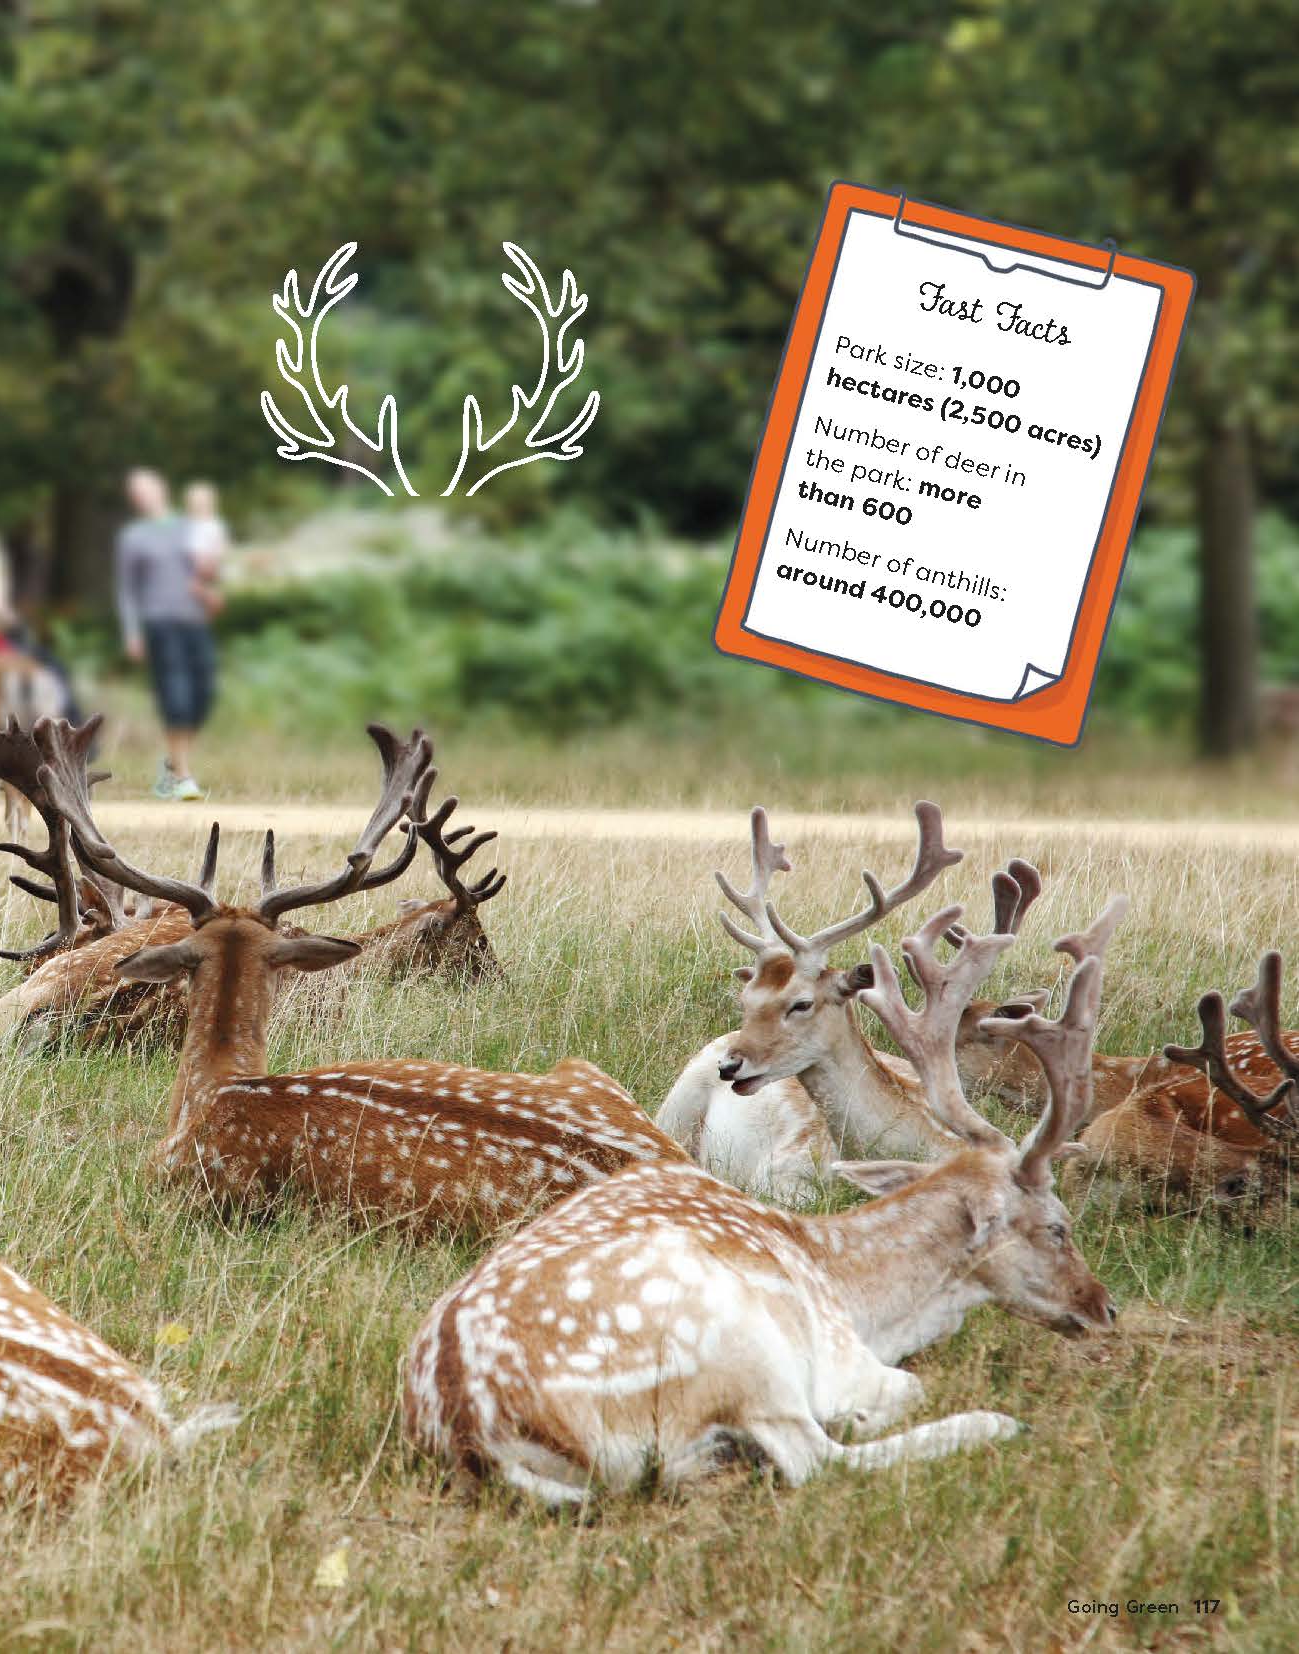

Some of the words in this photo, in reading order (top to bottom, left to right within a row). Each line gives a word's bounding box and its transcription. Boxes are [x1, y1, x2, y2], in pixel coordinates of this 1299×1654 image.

[919, 282, 982, 323] Fast
[996, 302, 1071, 345] Facts
[836, 336, 887, 366] Park
[894, 353, 944, 380] size:
[953, 366, 1020, 398] 1,000
[827, 367, 934, 411] hectares
[941, 397, 1021, 433] (2,500
[1028, 423, 1101, 460] acres)
[806, 449, 844, 473] the
[851, 464, 911, 491] park:
[919, 481, 981, 509] more
[815, 416, 910, 456] Number
[916, 446, 943, 463] of
[945, 452, 1000, 478] deer
[1005, 464, 1026, 487] in
[798, 481, 854, 510] than
[862, 498, 912, 525] 600
[777, 564, 866, 598] around
[871, 586, 981, 627] 400,000
[786, 528, 881, 567] Number
[887, 558, 914, 575] of
[916, 571, 1006, 601] anthills:
[1068, 1600, 1118, 1617] Going
[1127, 1600, 1179, 1613] Green
[1194, 1600, 1220, 1613] 117
